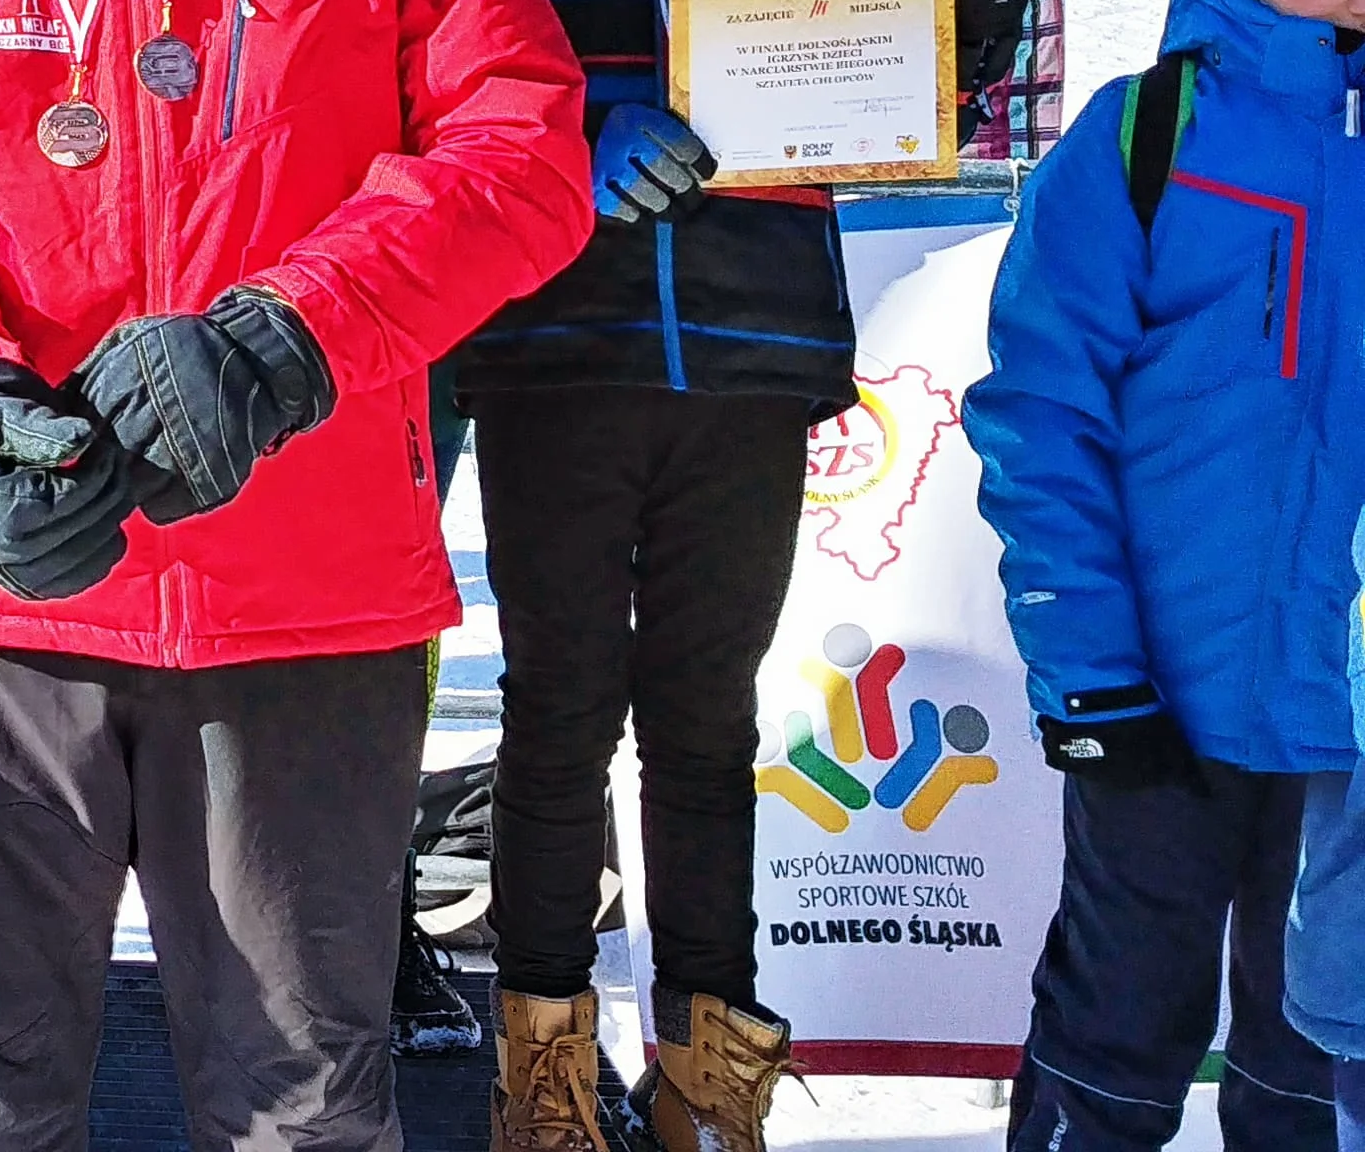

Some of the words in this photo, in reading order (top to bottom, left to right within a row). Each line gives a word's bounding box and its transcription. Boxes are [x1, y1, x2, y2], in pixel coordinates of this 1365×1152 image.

[850, 1, 902, 15] MIEJSCA
[768, 51, 819, 64] IGRZYSK
[822, 48, 863, 60] DZIECI
[741, 61, 833, 77] NARCIARSTWIE
[836, 55, 904, 70] BIEGOWYM
[802, 142, 834, 151] DOLNY
[805, 489, 840, 503] OLNY
[769, 851, 985, 879] WSPÓŁZAWODNICTWO
[798, 885, 911, 909] SPORTOWE
[913, 882, 970, 909] SZKÓŁ
[770, 918, 903, 946] DOLNEGO
[907, 914, 1003, 953] ŚLĄSKA
